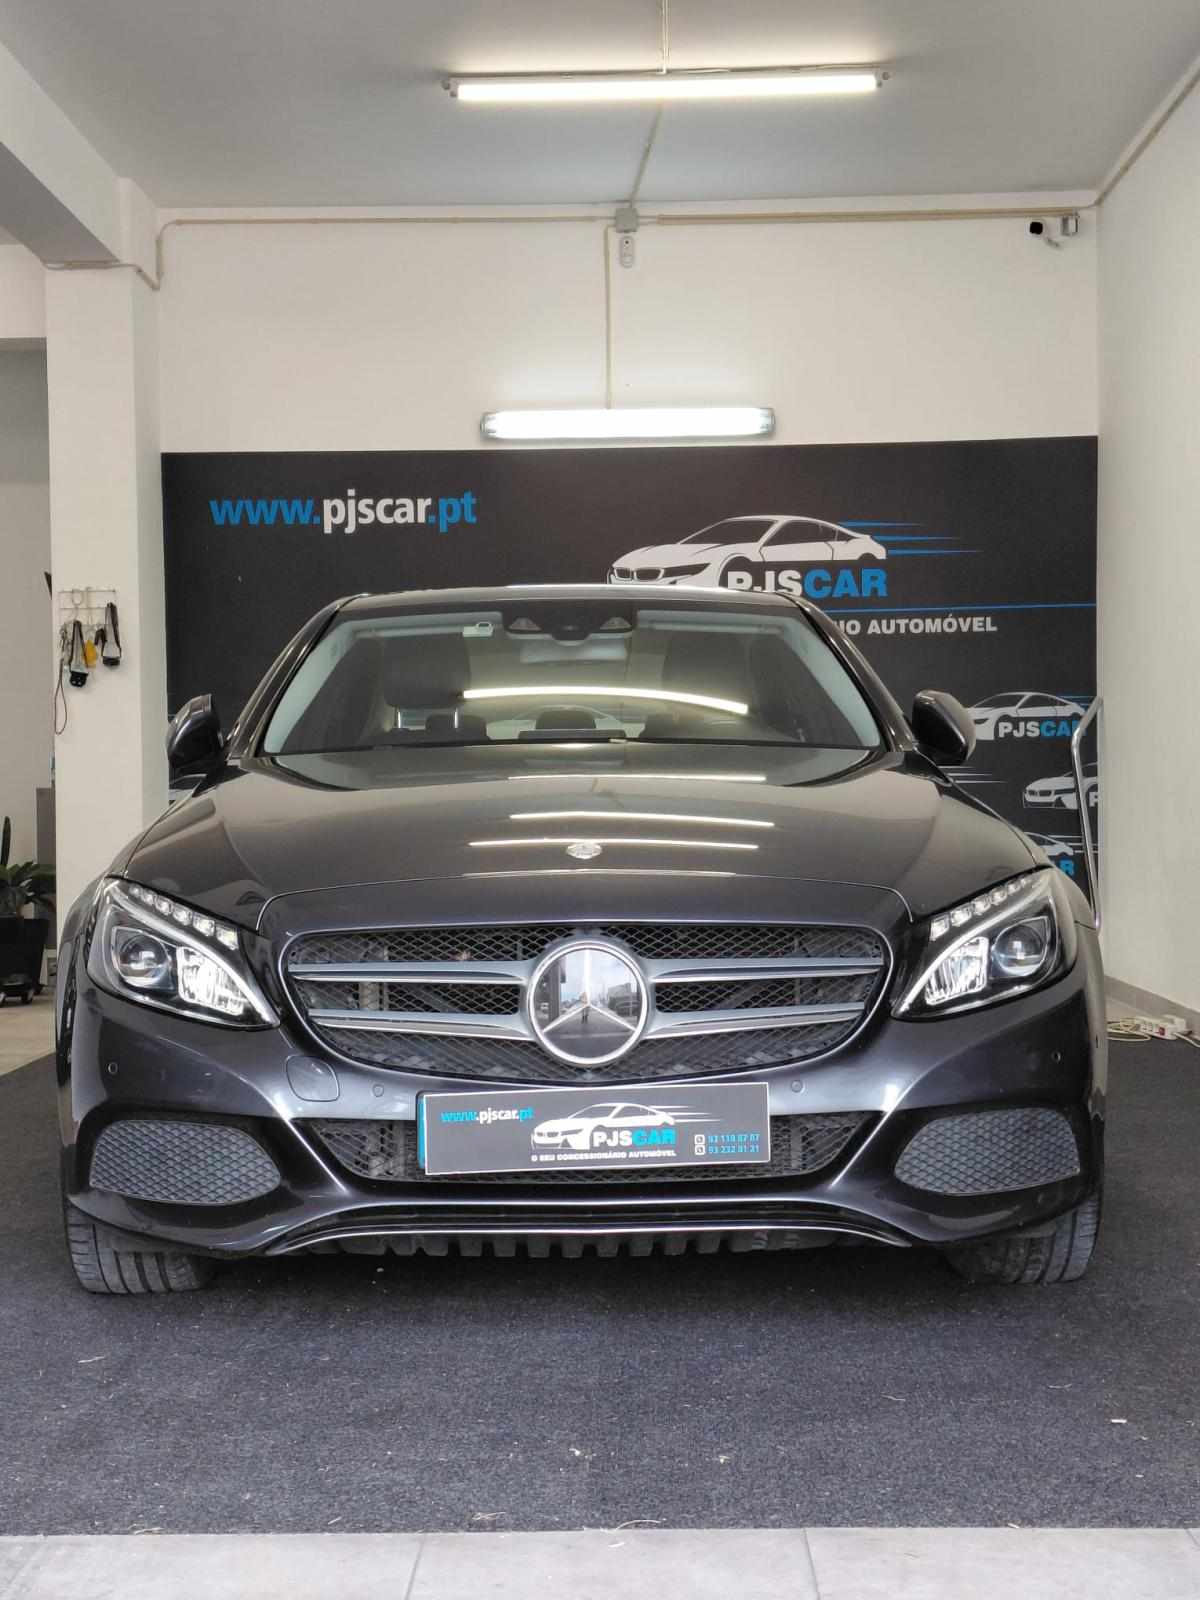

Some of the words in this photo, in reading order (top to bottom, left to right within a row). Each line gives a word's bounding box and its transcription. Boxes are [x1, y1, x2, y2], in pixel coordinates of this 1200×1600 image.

[208, 488, 478, 534] www.pjscar.pt
[727, 568, 889, 599] PJSCAR
[867, 615, 998, 635] AUTOMÓVEL
[440, 1107, 534, 1124] www.pjscar.pt
[592, 1128, 677, 1147] PJSCAR
[628, 1148, 678, 1159] AUTOMÓVEL
